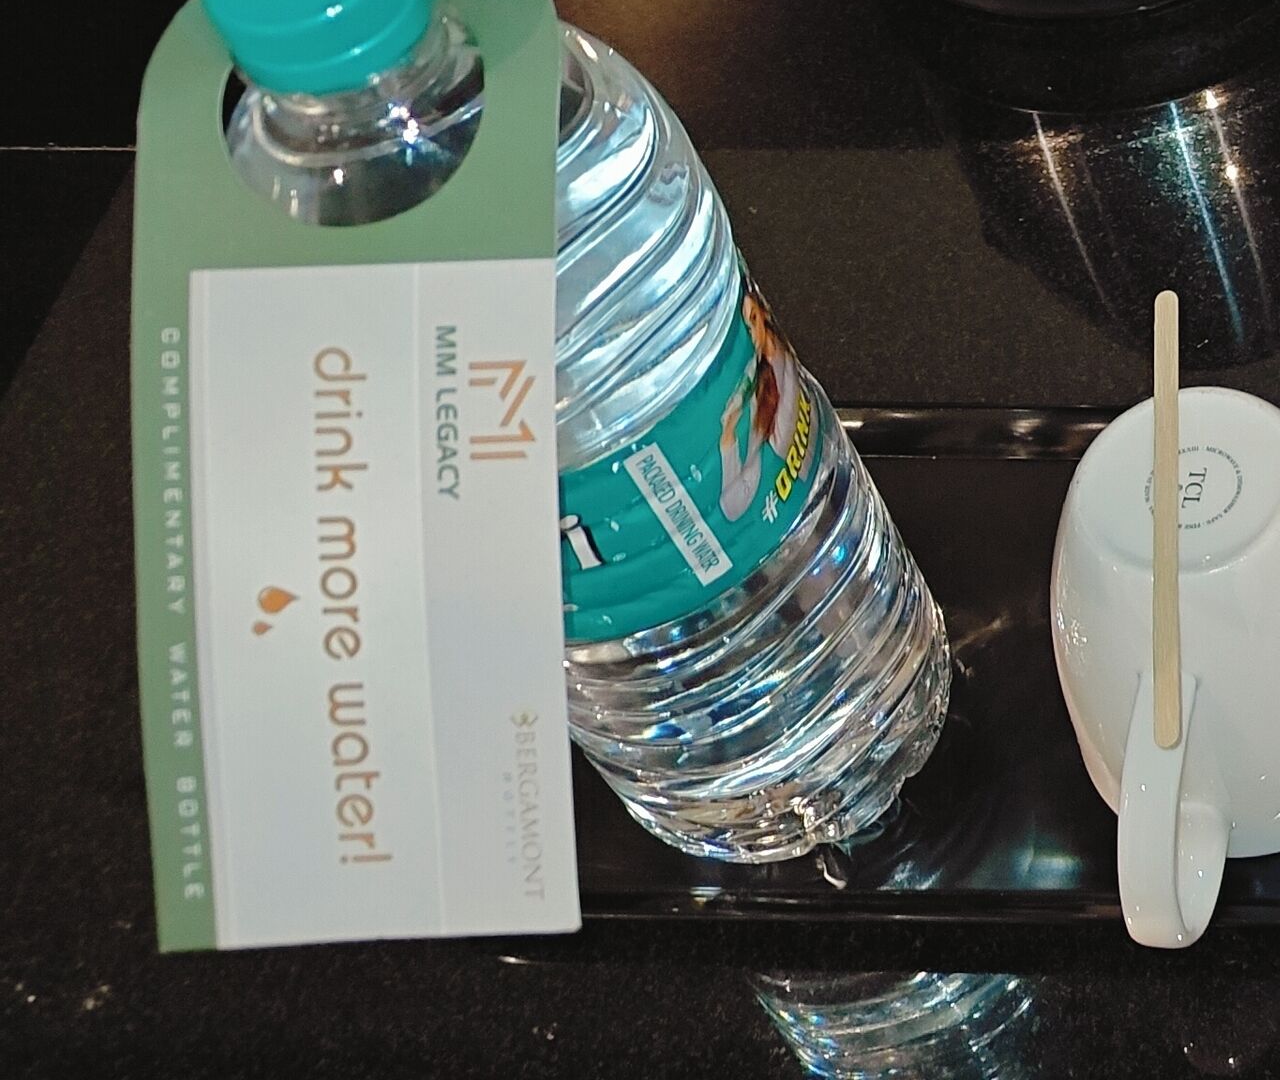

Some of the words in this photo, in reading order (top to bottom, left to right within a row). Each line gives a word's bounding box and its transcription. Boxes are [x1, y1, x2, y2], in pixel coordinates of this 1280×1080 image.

[434, 324, 457, 376] MM
[160, 326, 186, 614] COMPLIMENTARY
[313, 346, 368, 492] drink
[434, 387, 460, 500] LEGACY
[1181, 467, 1208, 509] TCL
[317, 515, 361, 660] more
[693, 532, 720, 574] WATER
[168, 642, 193, 748] WATER
[326, 681, 394, 865] water!
[514, 729, 546, 901] BERGAMONT
[176, 775, 205, 900] BOTTLE
